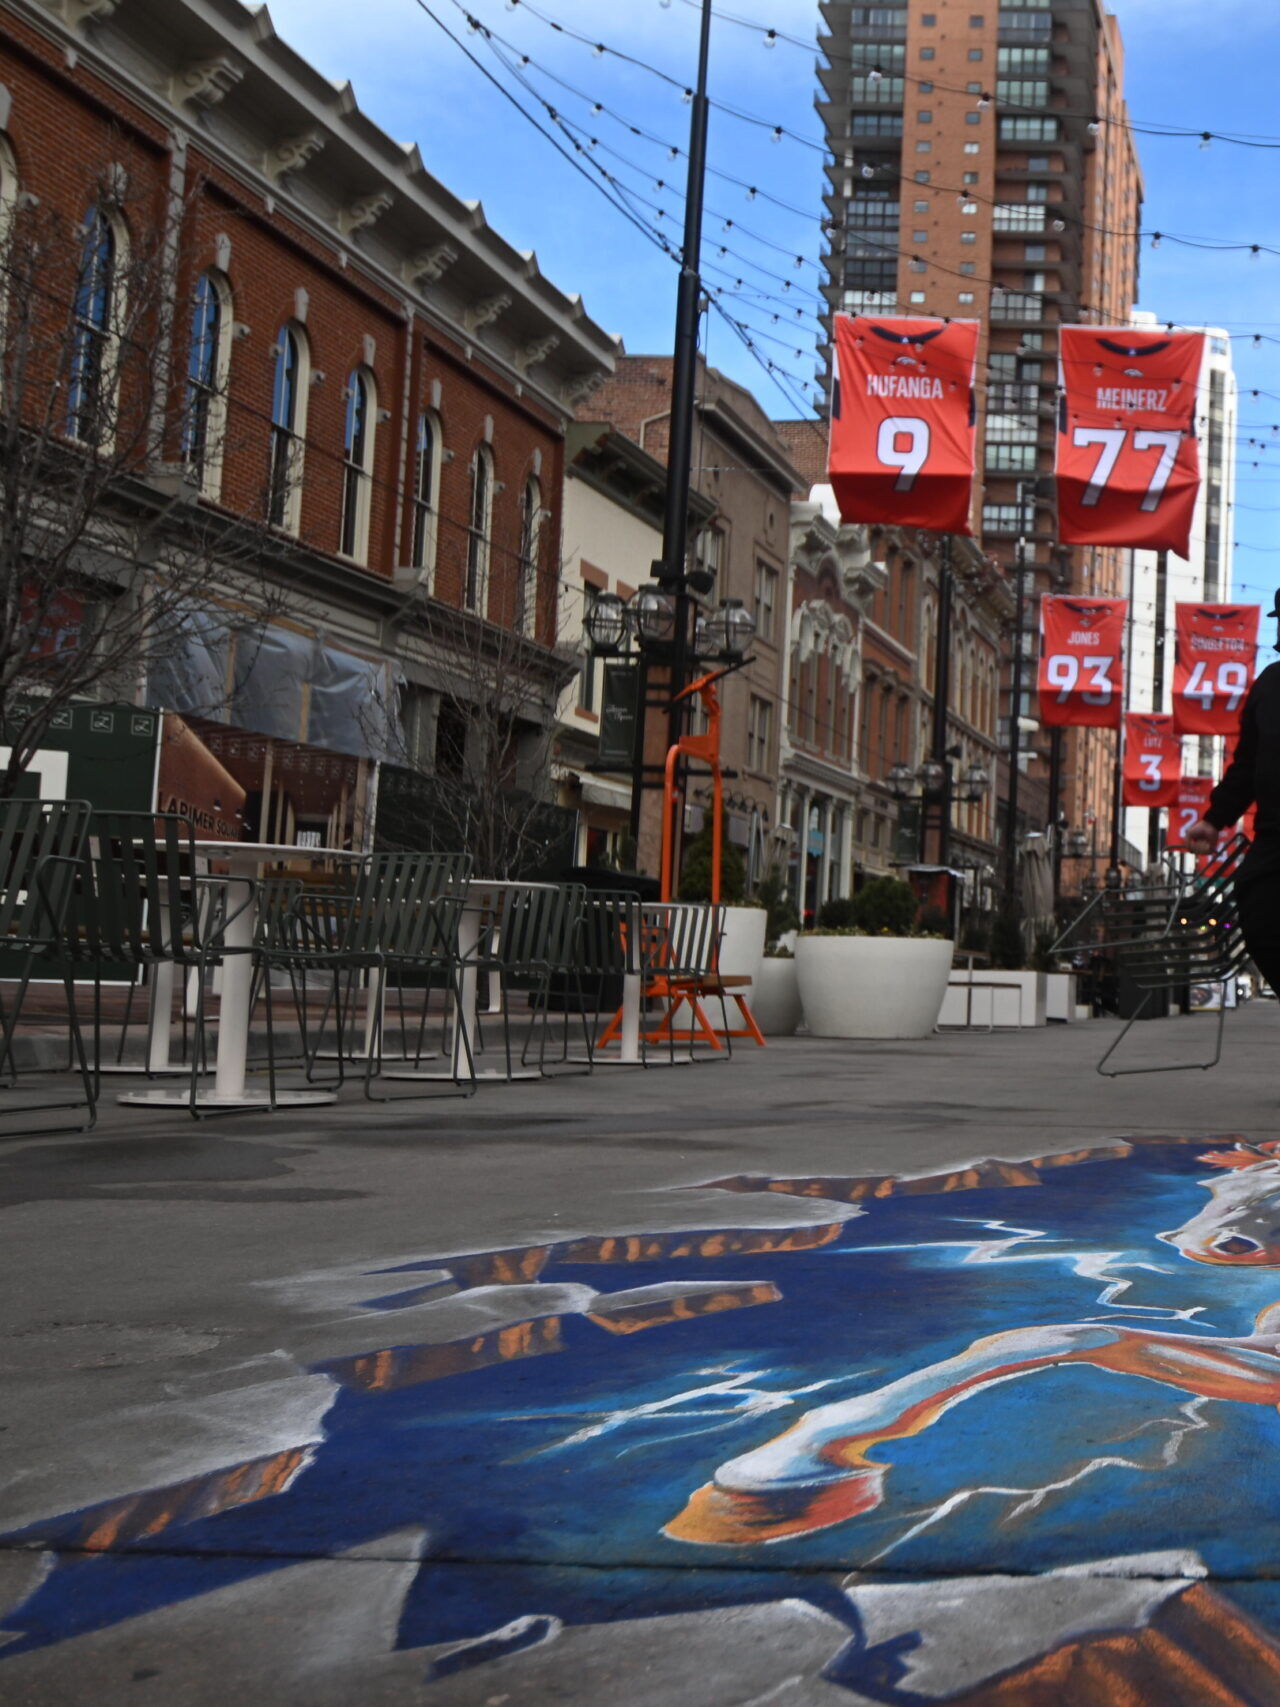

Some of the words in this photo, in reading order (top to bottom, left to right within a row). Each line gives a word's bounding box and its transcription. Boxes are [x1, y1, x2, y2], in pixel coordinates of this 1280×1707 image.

[866, 374, 944, 399] HUFANGA
[1096, 387, 1168, 412] MEINERZ
[877, 416, 931, 492] 9
[1073, 427, 1182, 512] 77
[1067, 631, 1100, 645] JONES
[1047, 654, 1114, 706] 93
[1183, 661, 1248, 711] 49
[1139, 754, 1164, 792] 3
[158, 791, 215, 831] LARIMER
